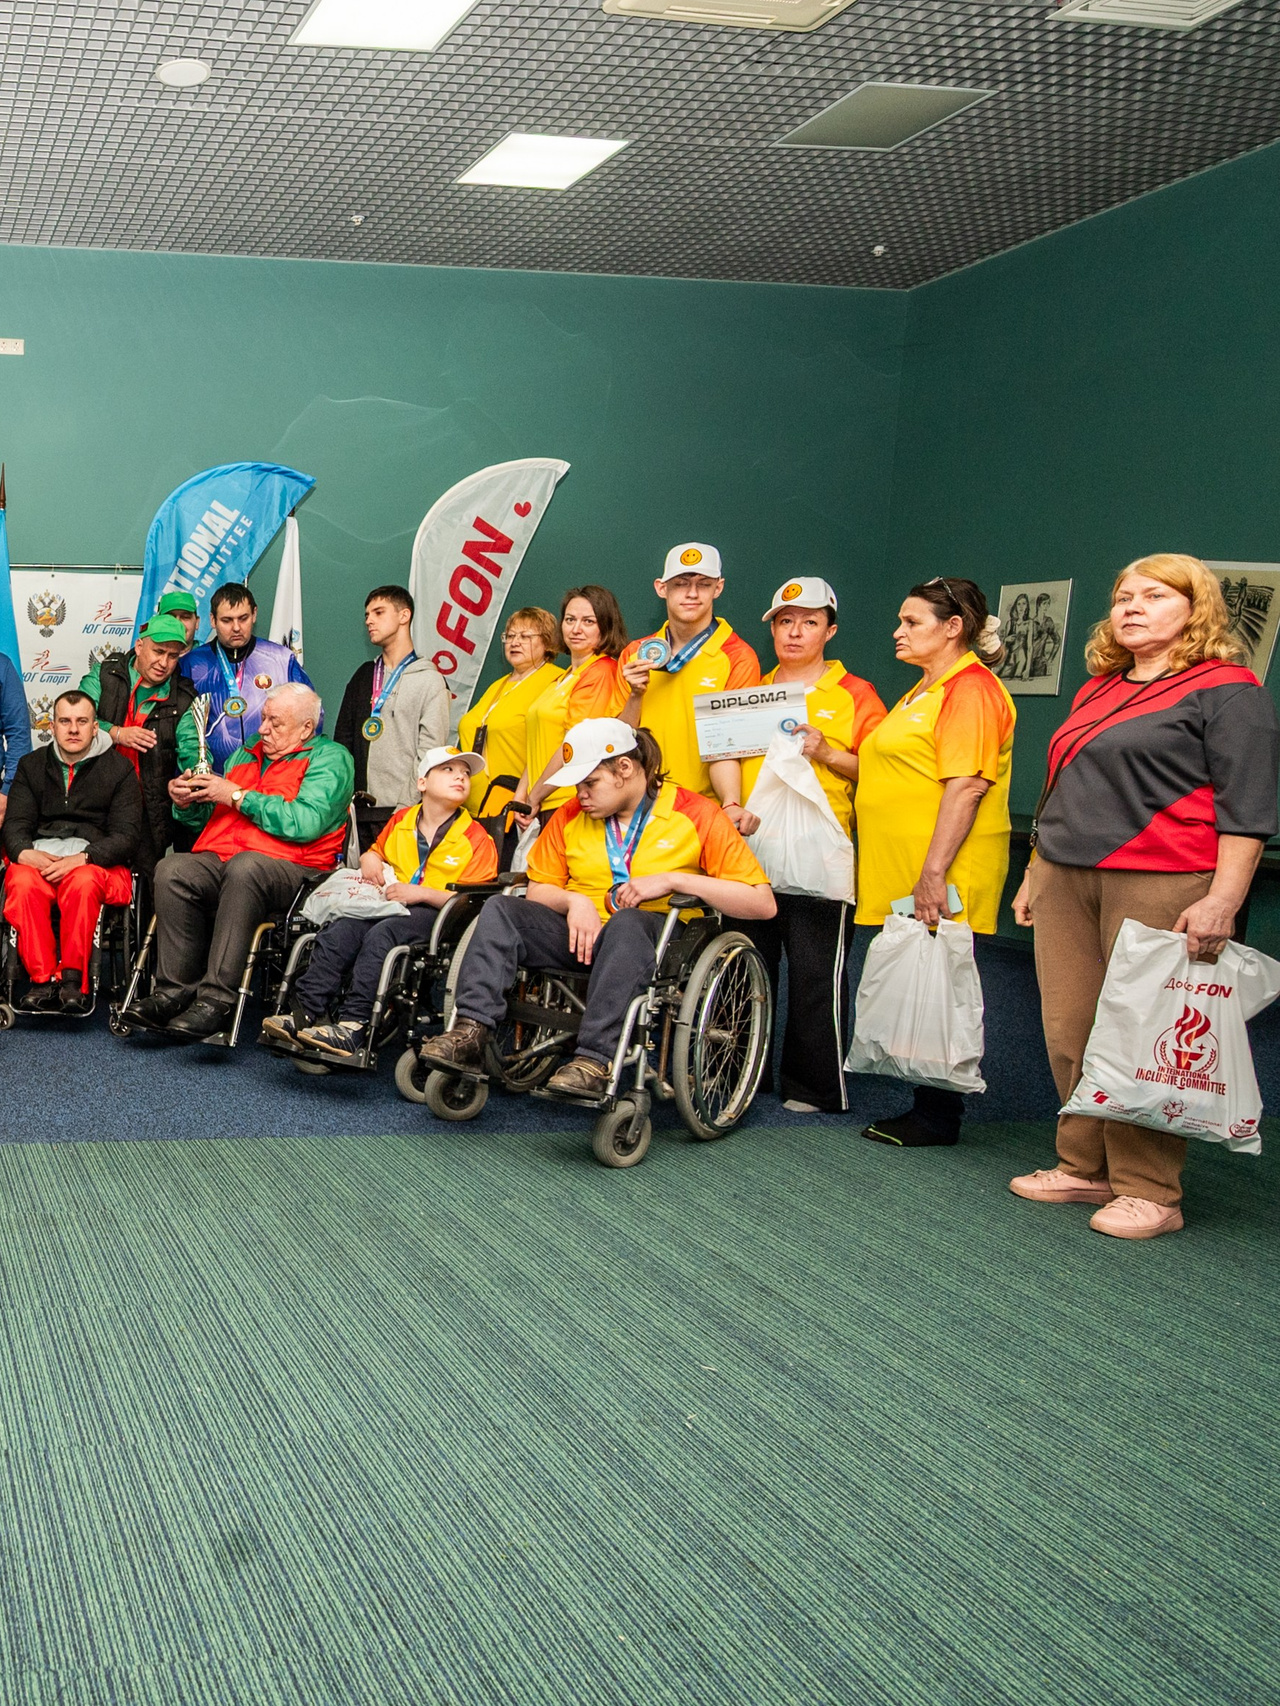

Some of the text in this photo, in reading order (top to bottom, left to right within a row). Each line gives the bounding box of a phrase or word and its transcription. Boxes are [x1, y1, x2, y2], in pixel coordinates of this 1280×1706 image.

[195, 515, 253, 600] OMMITTEE
[82, 624, 134, 637] ЮГ Спорт
[40, 672, 72, 685] Спорт
[710, 691, 787, 710] DIPLOMA
[1179, 1077, 1227, 1096] COMMITTEE
